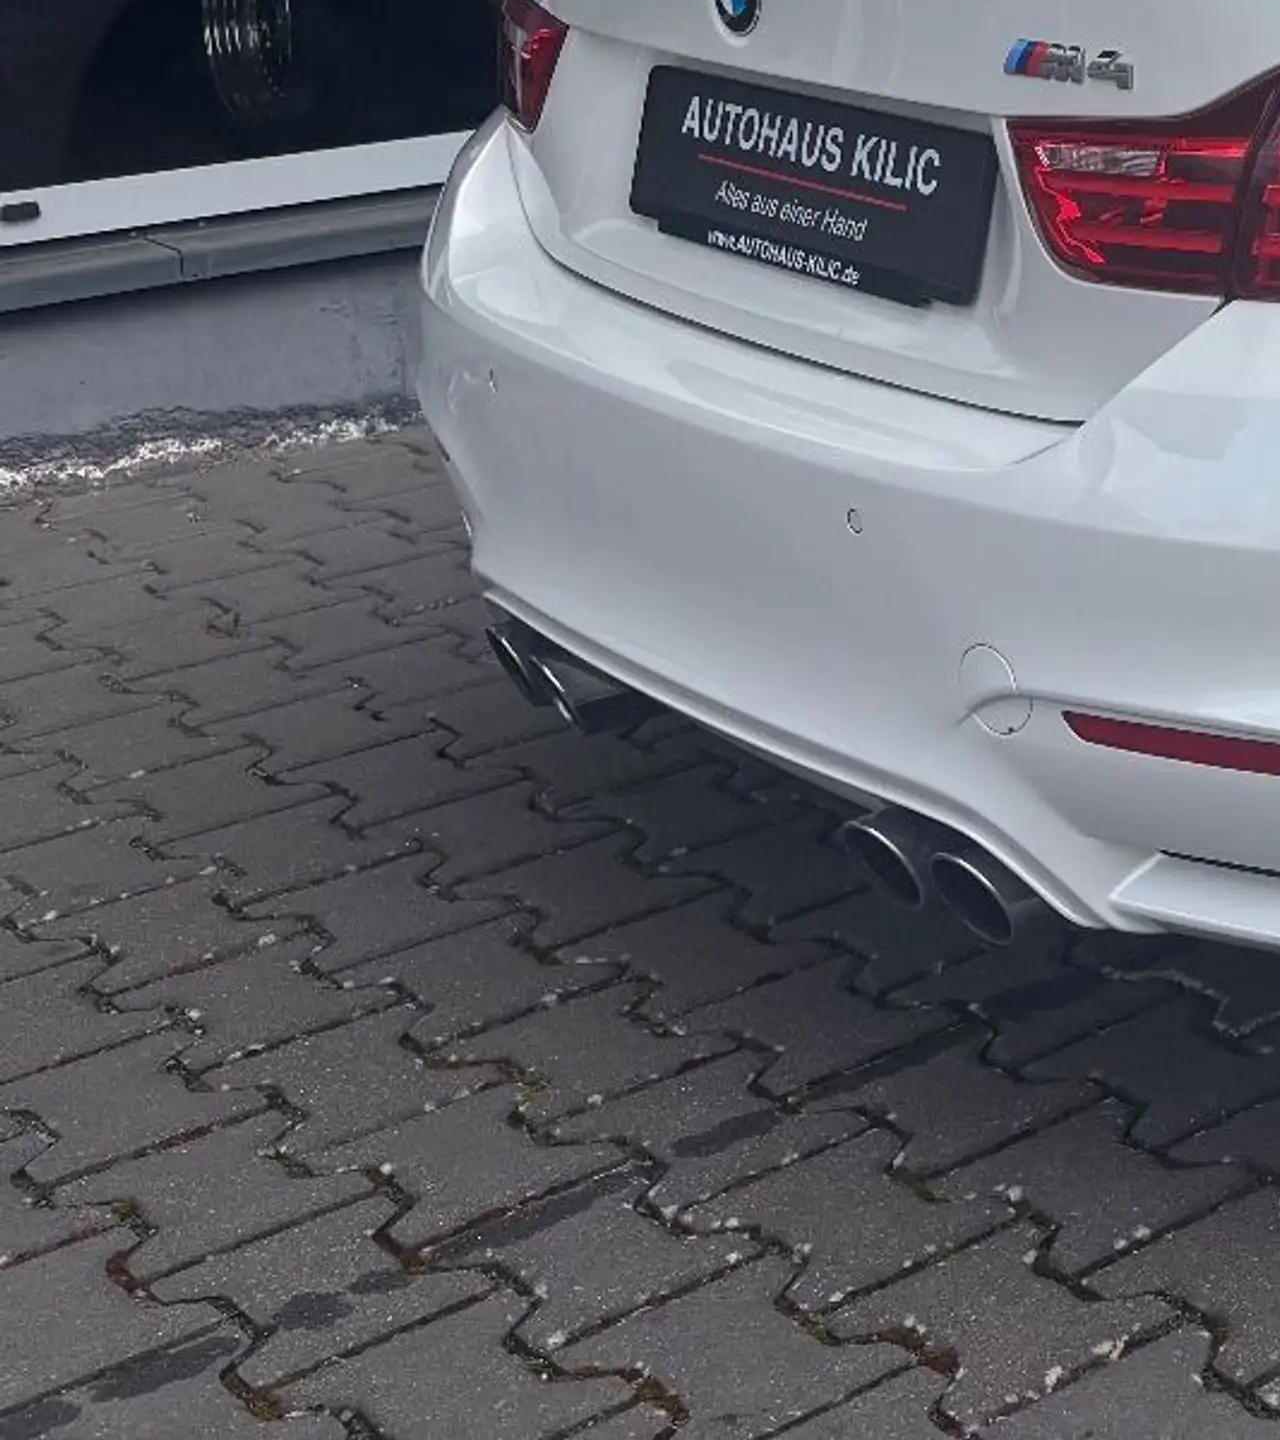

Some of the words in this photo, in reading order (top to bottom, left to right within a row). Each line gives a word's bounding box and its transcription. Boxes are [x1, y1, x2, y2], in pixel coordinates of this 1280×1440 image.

[1040, 42, 1134, 91] M4
[681, 95, 844, 173] AUTOHAUS
[850, 133, 942, 196] KILIC
[750, 193, 779, 218] aus
[779, 199, 823, 228] einer
[820, 207, 869, 242] Hand
